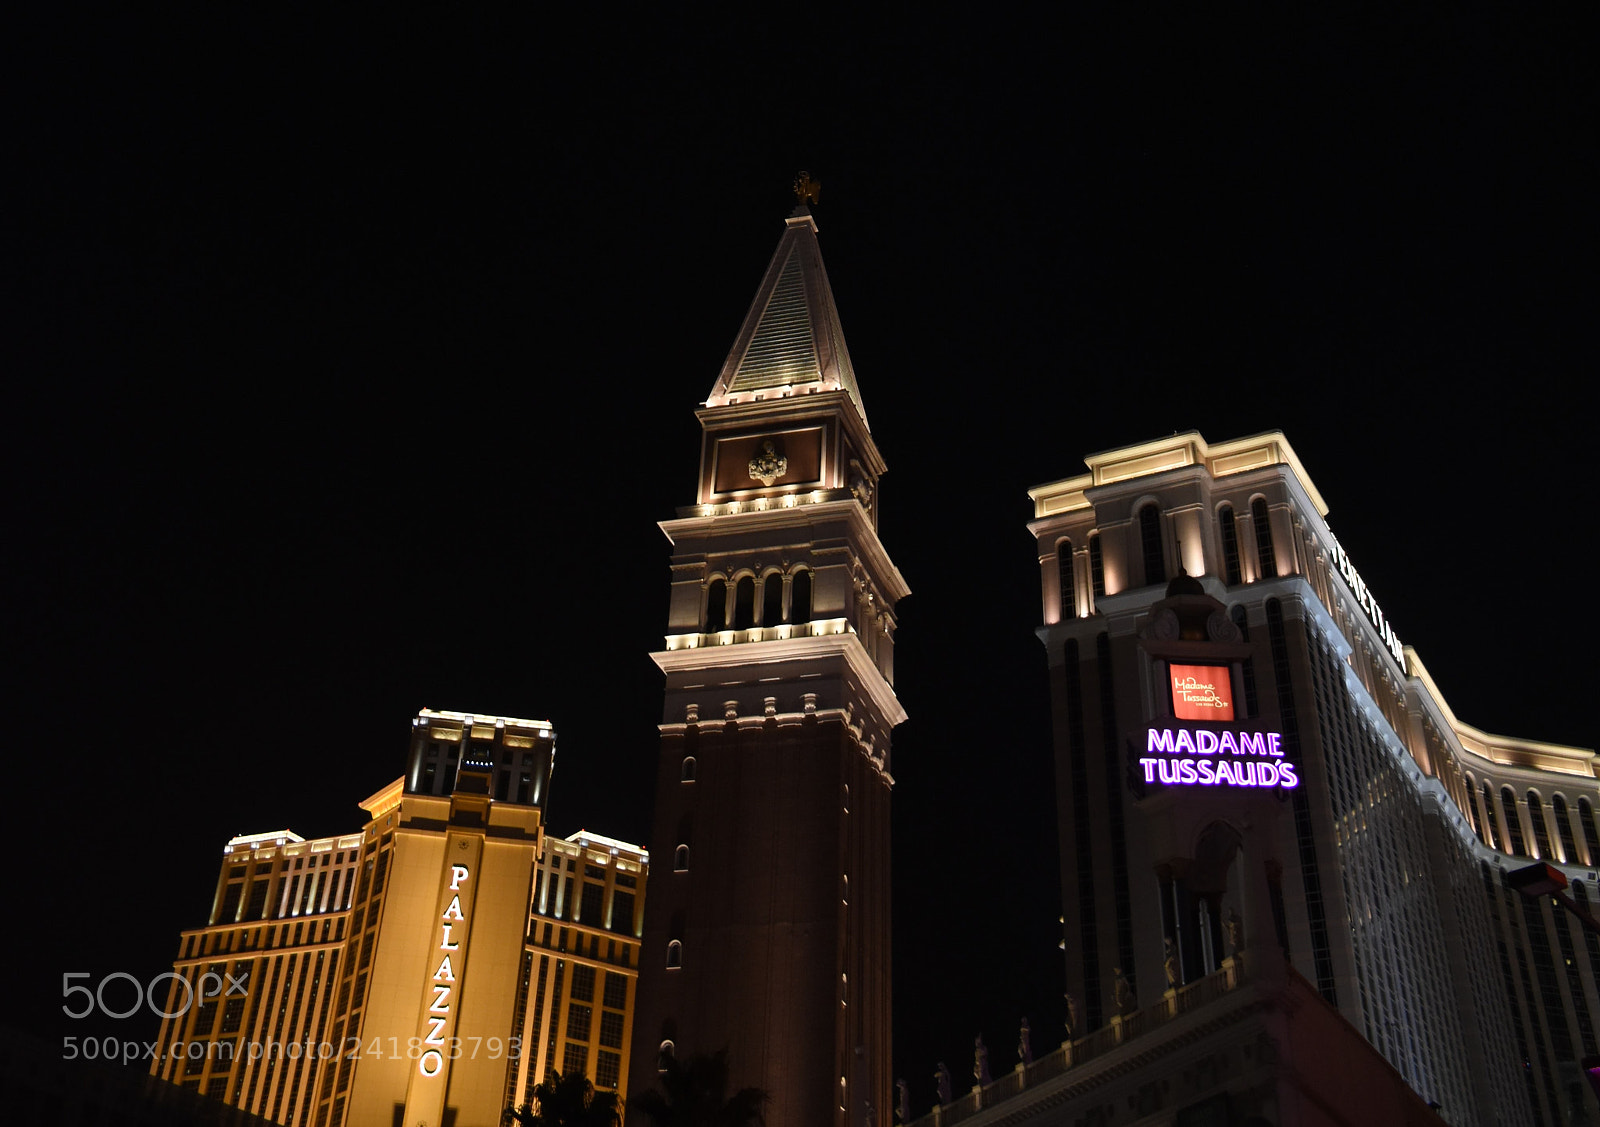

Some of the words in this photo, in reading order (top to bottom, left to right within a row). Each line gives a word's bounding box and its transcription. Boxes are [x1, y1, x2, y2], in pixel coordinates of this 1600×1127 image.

[1175, 677, 1215, 690] Madame
[1147, 728, 1285, 756] MADAME
[1139, 757, 1299, 788] TUSSAUD'S
[419, 863, 470, 1078] PALAZZO
